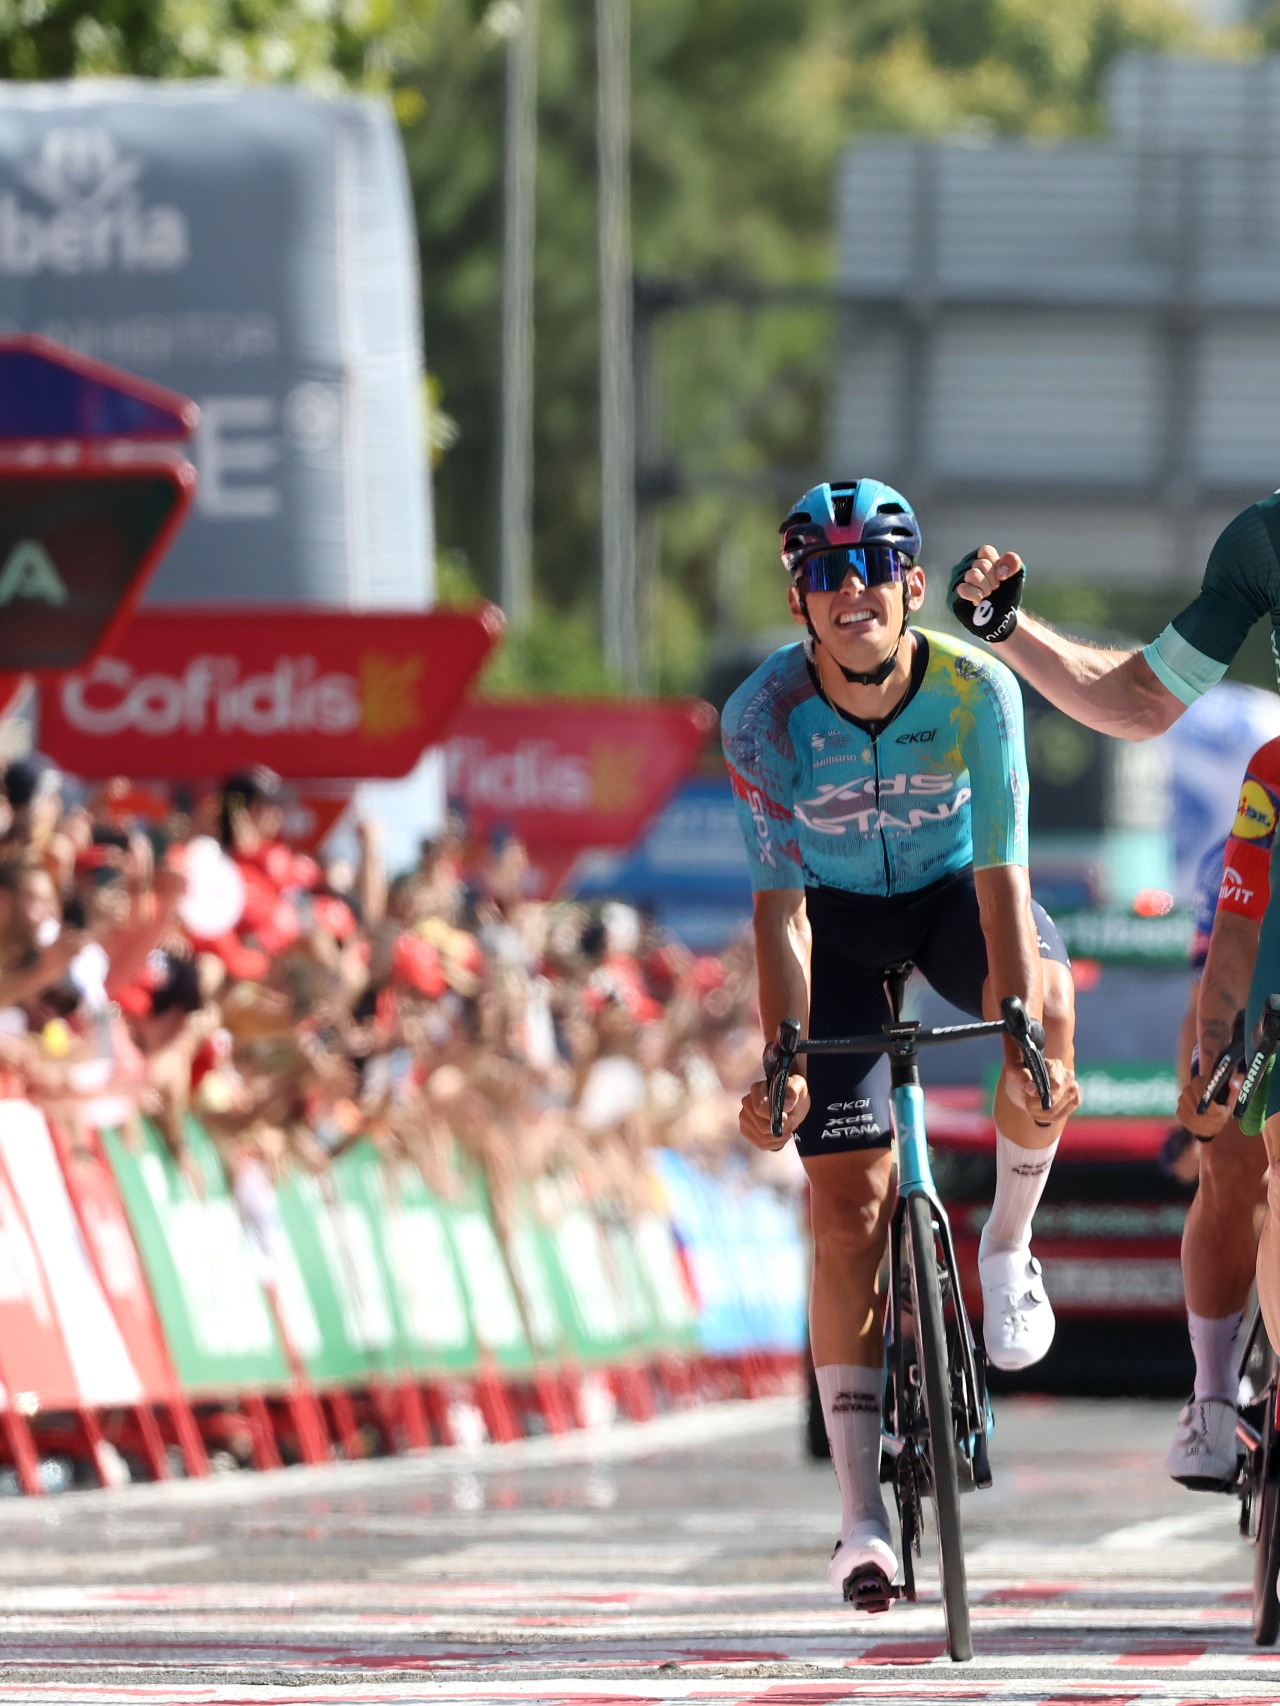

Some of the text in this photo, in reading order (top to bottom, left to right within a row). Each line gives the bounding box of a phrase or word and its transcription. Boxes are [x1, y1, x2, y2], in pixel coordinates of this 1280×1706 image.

[62, 655, 361, 737] Cofidis
[1237, 1051, 1266, 1105] SRAM
[820, 1122, 881, 1140] ASTANA
